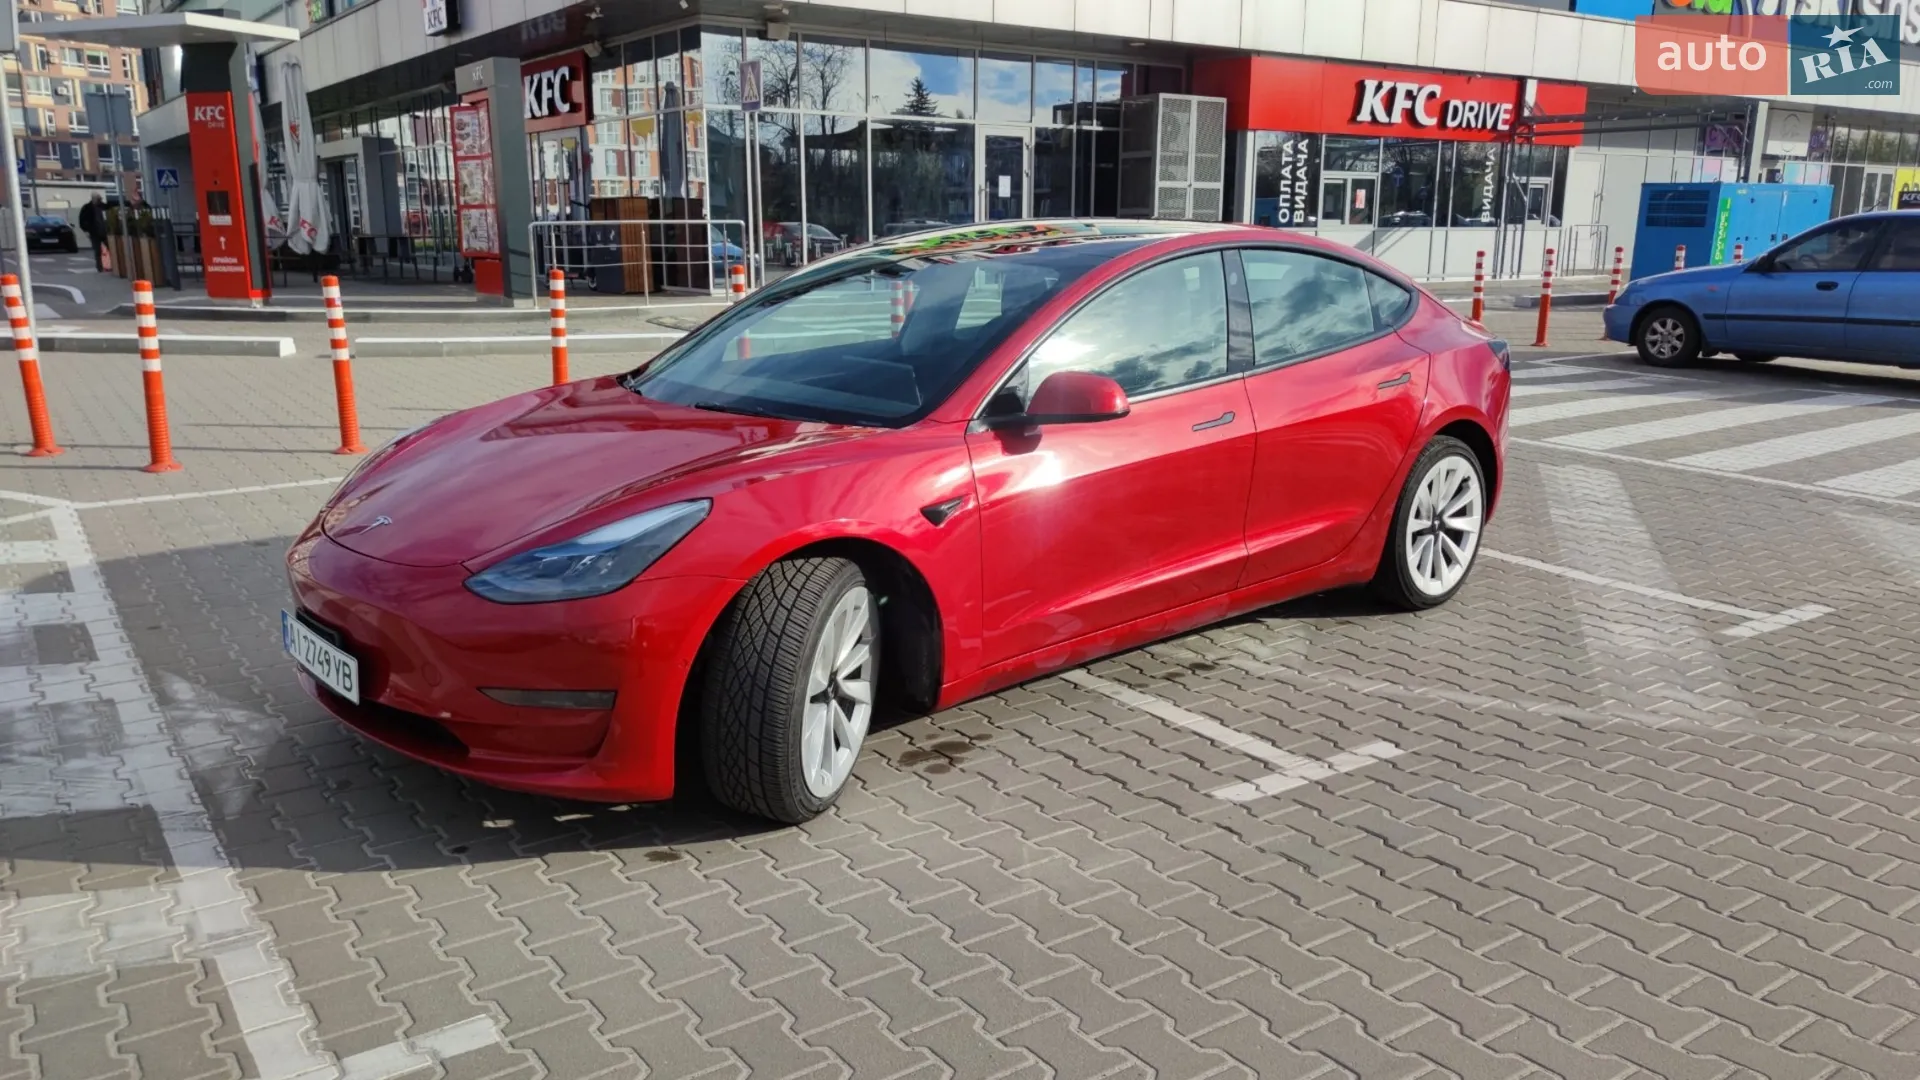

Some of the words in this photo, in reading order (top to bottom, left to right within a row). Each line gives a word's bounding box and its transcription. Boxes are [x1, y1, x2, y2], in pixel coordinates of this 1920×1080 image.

[426, 7, 443, 30] KFC
[194, 105, 226, 121] KFC
[524, 66, 570, 119] KFC
[1356, 79, 1442, 126] KFC
[1446, 99, 1513, 131] DRIVE
[1278, 139, 1294, 223] ОПЛАТА
[1293, 138, 1309, 223] ВИДАЧА
[1481, 147, 1496, 223] ВИДАЧА
[290, 622, 301, 657] AI
[302, 635, 331, 678] 2749
[332, 654, 353, 693] YB
